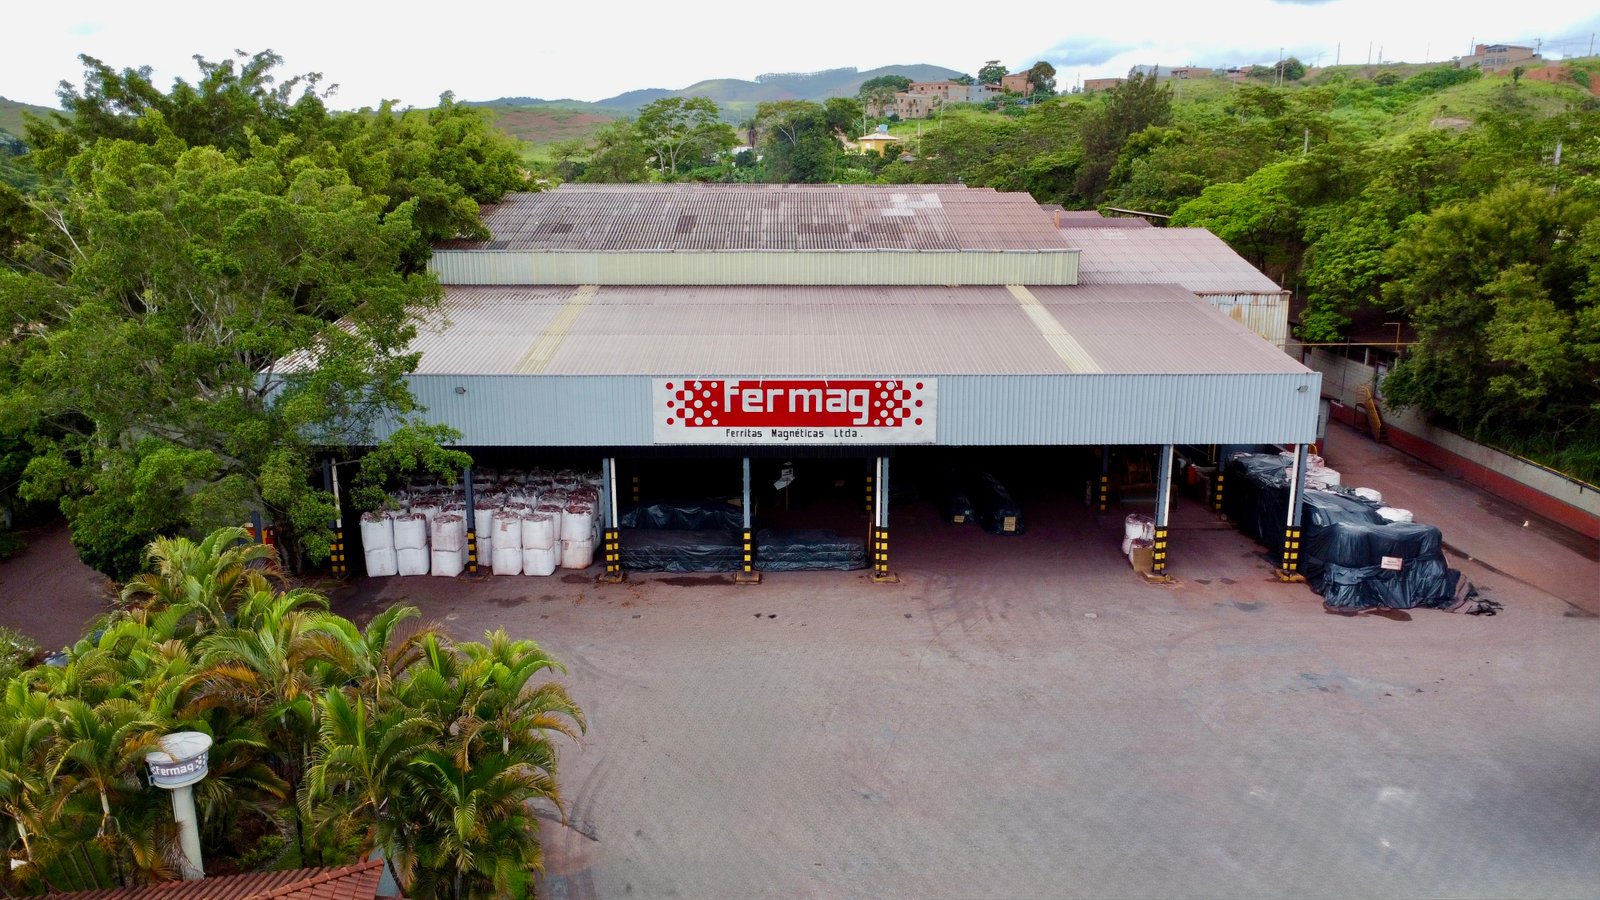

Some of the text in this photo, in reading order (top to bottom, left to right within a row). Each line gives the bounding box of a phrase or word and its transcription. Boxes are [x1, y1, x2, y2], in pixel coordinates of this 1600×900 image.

[724, 379, 870, 425] fermag
[726, 428, 863, 441] Ferritas Magnéticas Ltda.
[156, 763, 194, 776] fermag
